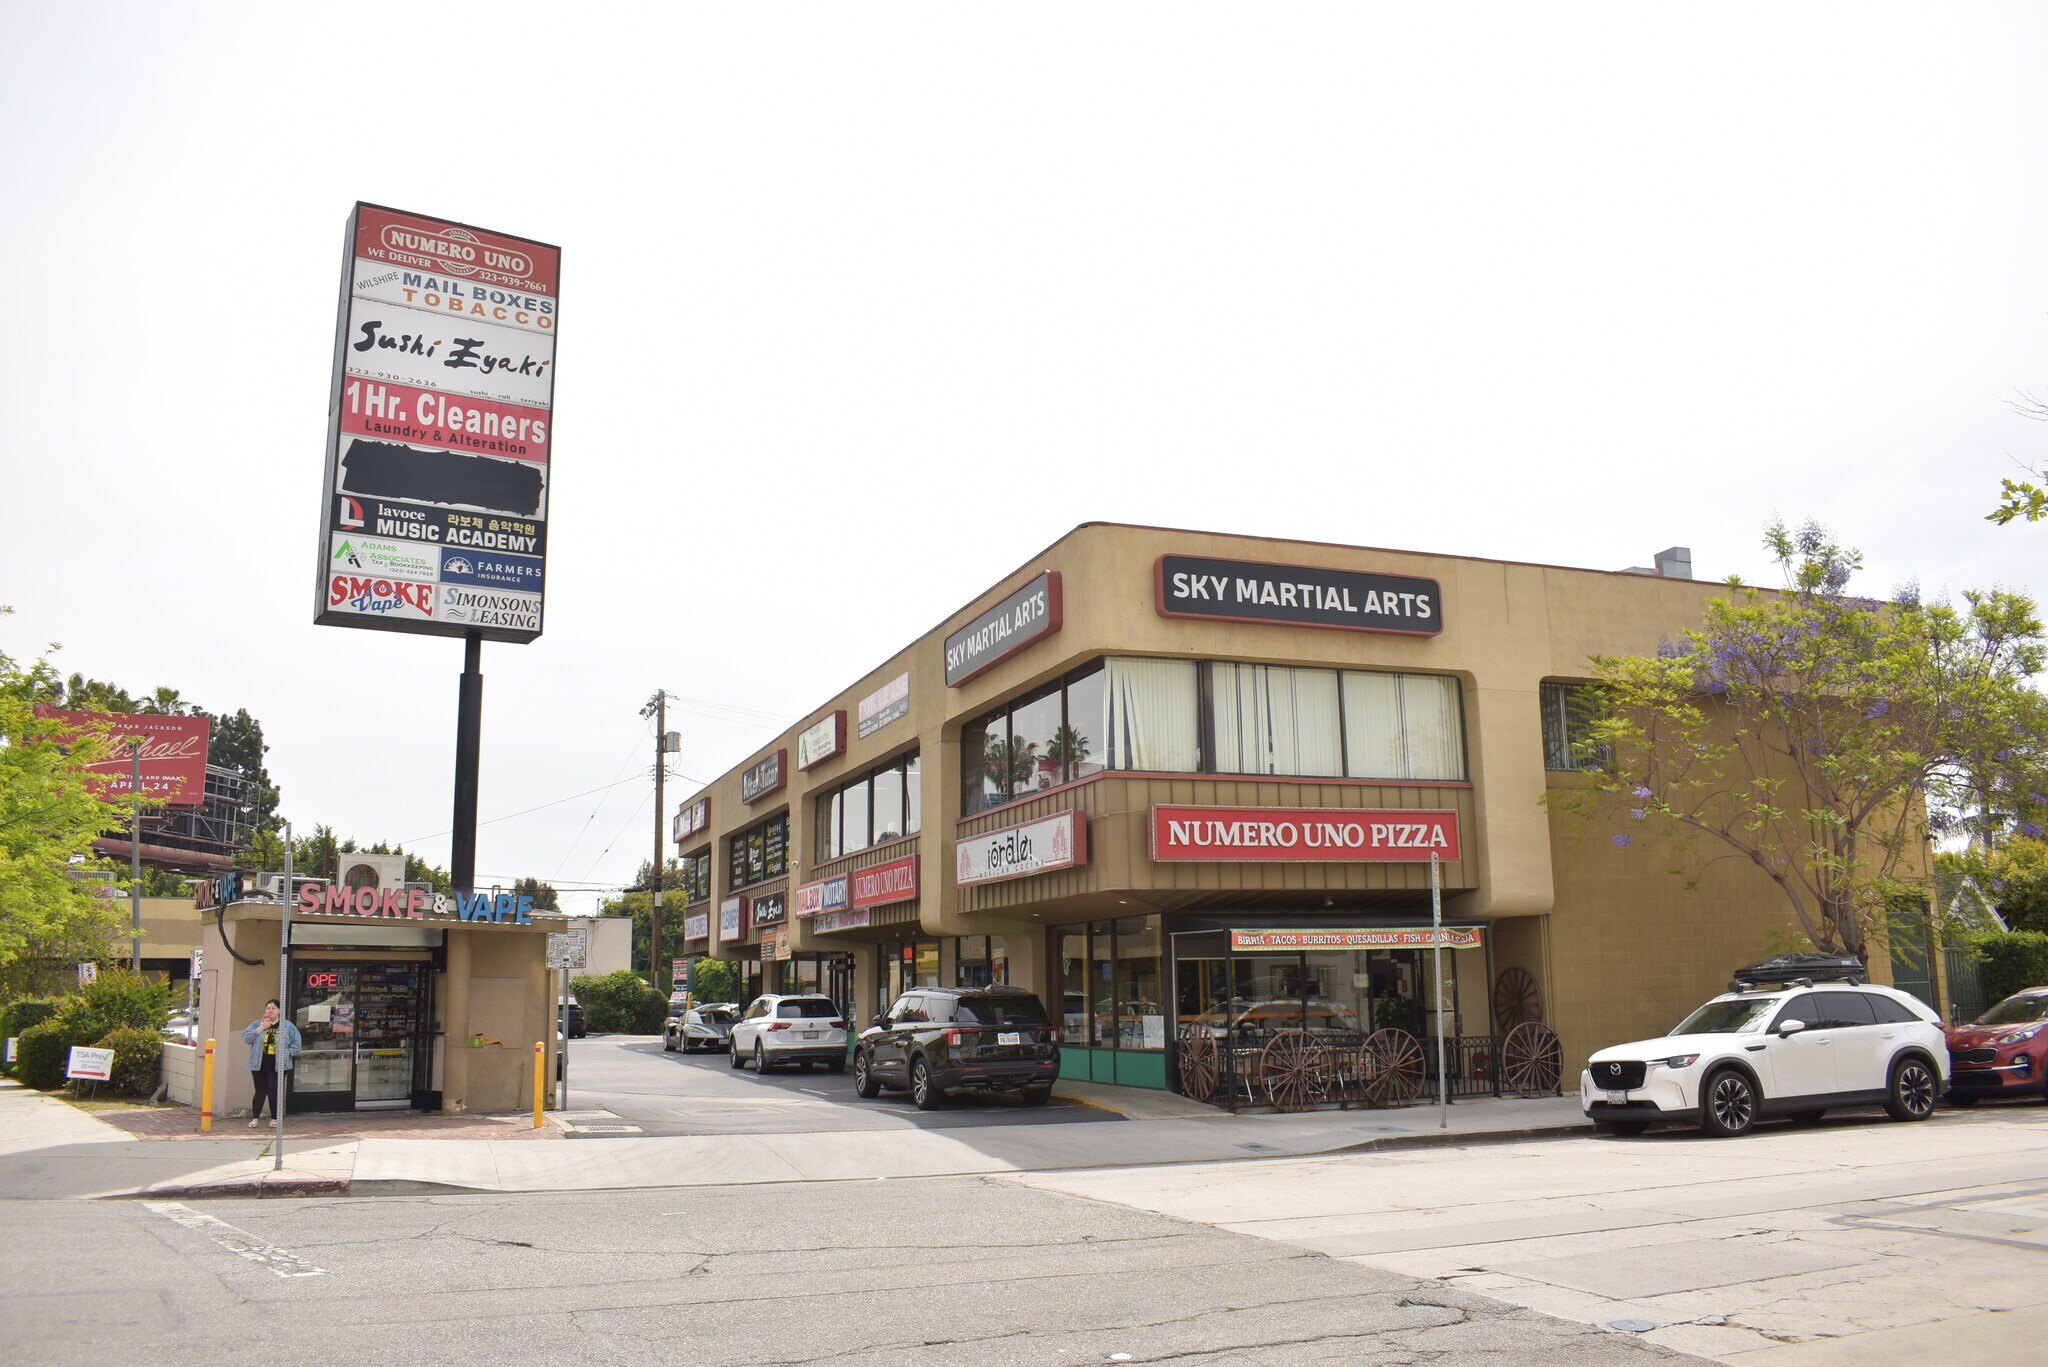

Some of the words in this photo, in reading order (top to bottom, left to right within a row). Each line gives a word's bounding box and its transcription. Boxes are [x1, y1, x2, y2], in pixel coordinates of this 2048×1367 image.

[367, 247, 385, 258] WE
[389, 252, 431, 268] DELIVER
[391, 230, 476, 262] NUMERO
[484, 250, 525, 272] UNO
[356, 271, 399, 290] WILSHIRE
[479, 270, 547, 292] 323-939-7661
[403, 272, 464, 296] MAIL
[473, 286, 553, 314] BOXES
[402, 289, 552, 329] TOBACCO
[353, 321, 442, 358] Sushi
[347, 366, 437, 387] 323-930-2636
[520, 398, 549, 407] teriyaki
[417, 393, 546, 444] Cleaners
[365, 419, 427, 440] Laundry
[433, 430, 442, 441] &
[449, 433, 527, 455] Alteration
[378, 504, 426, 521] lavoce
[377, 518, 440, 540] MUSIC
[446, 528, 537, 552] ACADEMY
[447, 514, 483, 529] 라보체
[488, 519, 535, 536] 음악학원
[361, 541, 397, 552] ADAMS
[370, 553, 427, 565] ASSOCIATES
[478, 562, 542, 577] FARMERS
[478, 573, 521, 583] INSURANCE
[331, 575, 433, 617] SMOKE
[351, 594, 405, 614] Vape
[444, 587, 542, 614] SIMONSONS
[1172, 572, 1229, 601] SKY
[1235, 578, 1358, 613] MARTIAL
[1363, 590, 1431, 619] ARTS
[470, 609, 537, 629] LEASING
[947, 641, 965, 672] SKY
[967, 613, 1012, 659] MARTIAL
[1015, 590, 1045, 631] ARTS
[110, 781, 147, 790] APRL
[1168, 820, 1298, 848] NUMERO
[1302, 822, 1364, 848] UNO
[1370, 823, 1449, 848] PIZZA
[980, 867, 1010, 879] MEXICAN
[1015, 860, 1044, 872] COCINA
[823, 878, 847, 906] NOTARY
[855, 873, 880, 900] NUMERO
[880, 869, 894, 895] UNO
[894, 865, 914, 891] PIZZA
[298, 883, 426, 919] SMOKE
[433, 894, 449, 914] &
[456, 891, 534, 923] VAPE
[1237, 935, 1265, 945] BIRRIA
[1271, 935, 1297, 945] TACOS
[1302, 935, 1341, 944] BURRITOS
[1347, 934, 1399, 945] QUESADILLAS
[1404, 934, 1421, 943] FISH
[308, 973, 348, 987] OPEN
[77, 1051, 89, 1059] TSA
